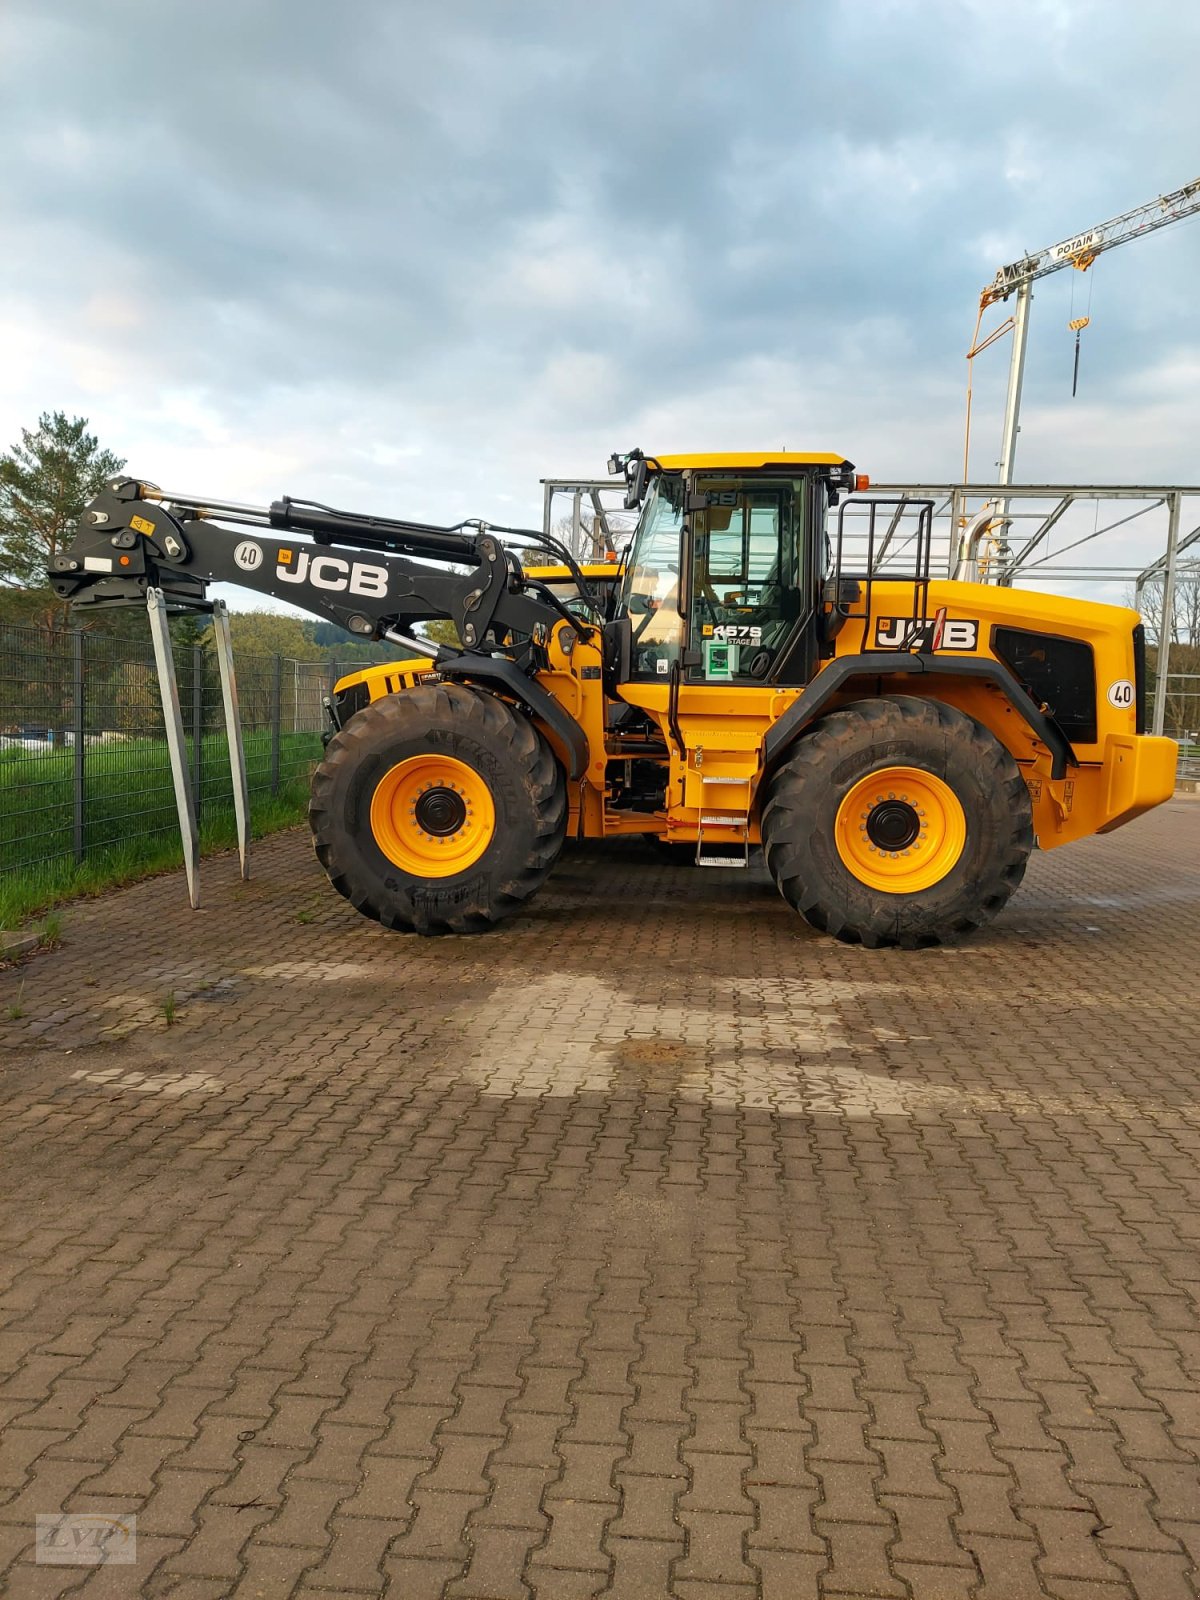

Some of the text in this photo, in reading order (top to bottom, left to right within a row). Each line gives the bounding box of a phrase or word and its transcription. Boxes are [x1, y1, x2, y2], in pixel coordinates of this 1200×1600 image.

[1057, 234, 1093, 256] POTAIN
[240, 546, 257, 565] 40
[276, 552, 389, 599] JCB
[713, 625, 762, 637] 457S
[727, 638, 751, 646] STAGE
[1114, 685, 1131, 703] 40
